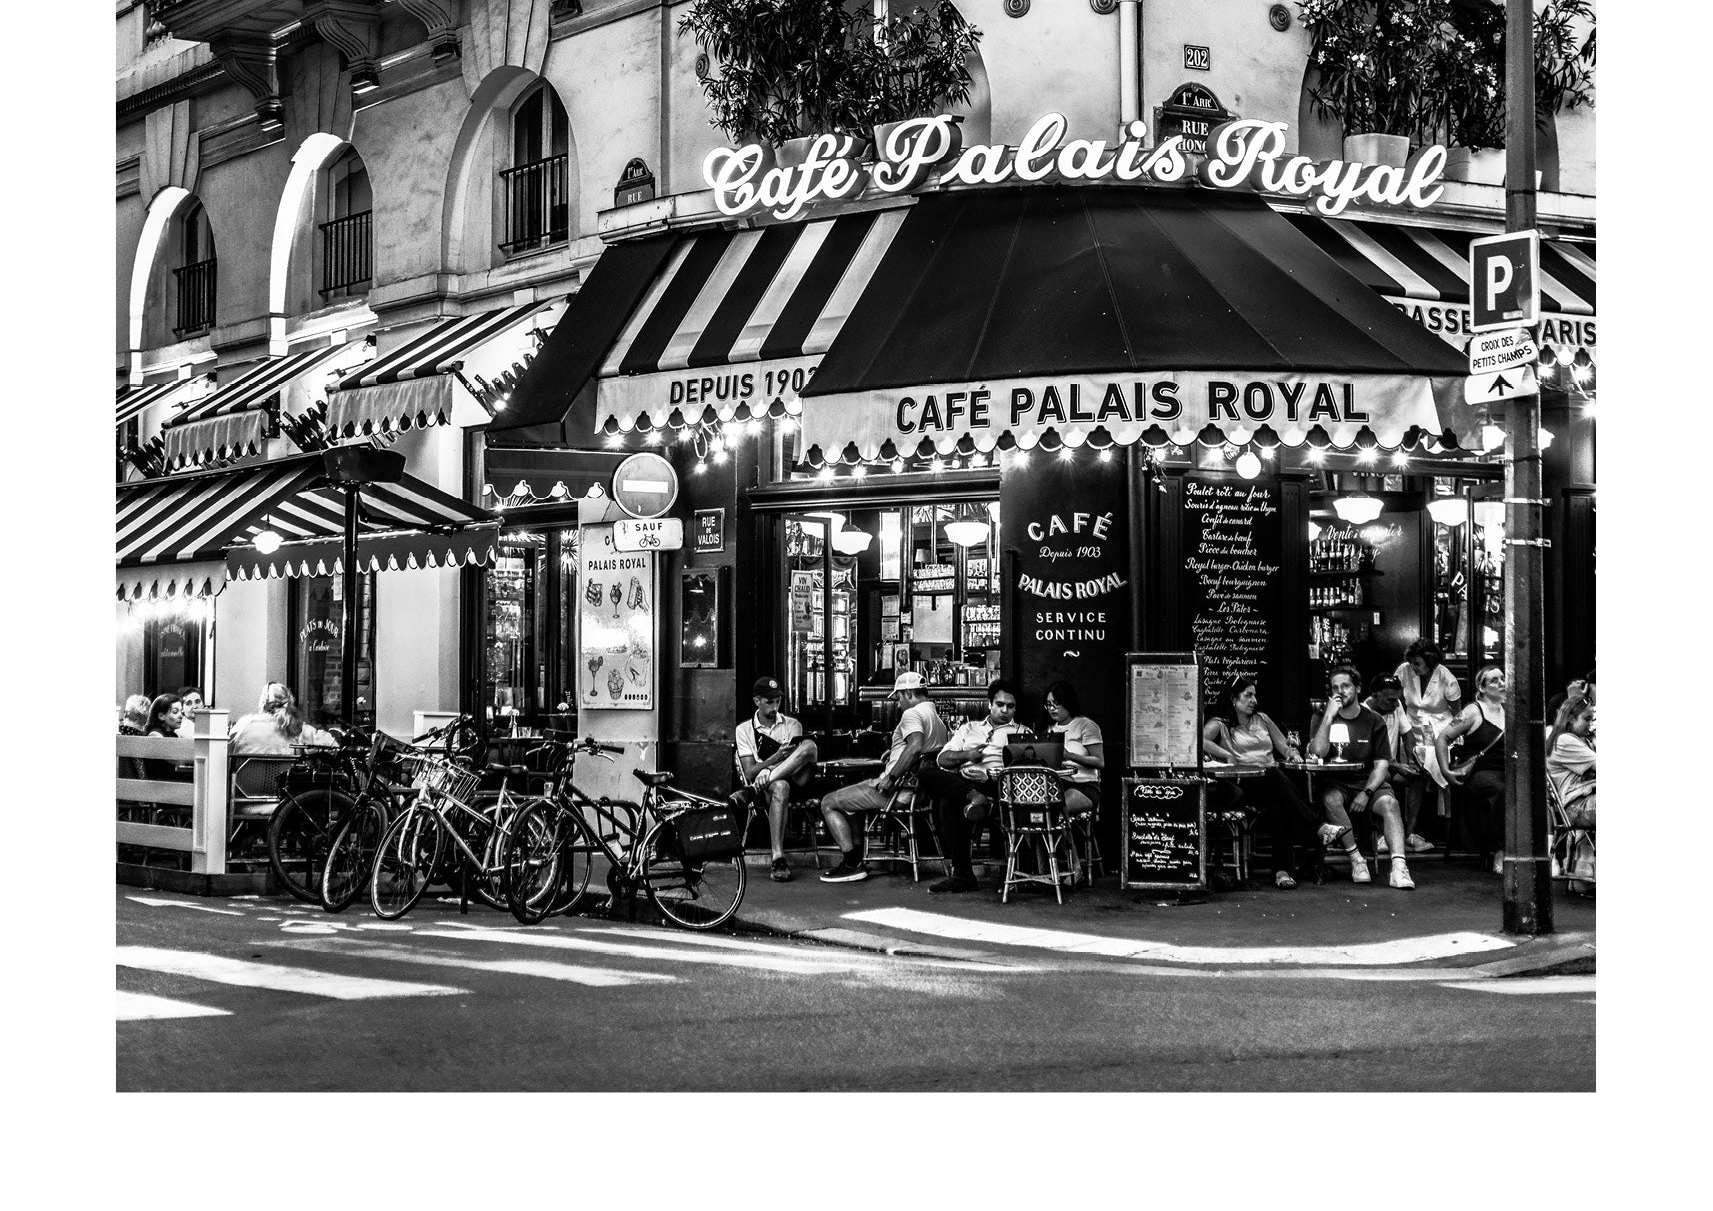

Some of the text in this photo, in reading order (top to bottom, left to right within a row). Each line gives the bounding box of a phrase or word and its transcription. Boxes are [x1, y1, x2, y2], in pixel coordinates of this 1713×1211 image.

[1187, 49, 1208, 67] 202
[1182, 120, 1208, 136] RUE
[702, 112, 1448, 220] Café Palais Royal
[628, 191, 642, 204] RUE
[1487, 255, 1513, 311] P
[1541, 318, 1596, 348] ARIS
[1481, 336, 1514, 352] CROIX DES
[1472, 345, 1533, 368] PETITS CHAMPS
[670, 373, 754, 406] DEPUIS
[896, 380, 1370, 434] CAFÉ PALAIS ROYAL
[1186, 482, 1214, 496] Poulet
[1247, 486, 1270, 502] four
[635, 522, 663, 531] SAUF
[702, 516, 716, 527] RUE
[1028, 512, 1114, 542] CAFÉ
[1202, 512, 1223, 530] Confit
[697, 534, 720, 545] VALOIS
[1326, 524, 1353, 540] Vente
[1039, 546, 1101, 563] Depuis 1903
[588, 557, 646, 571] PALAIS ROYAL
[1018, 572, 1128, 600] PALAIS ROYAL
[1036, 612, 1106, 623] SERVICE
[1036, 629, 1106, 640] CONTINU
